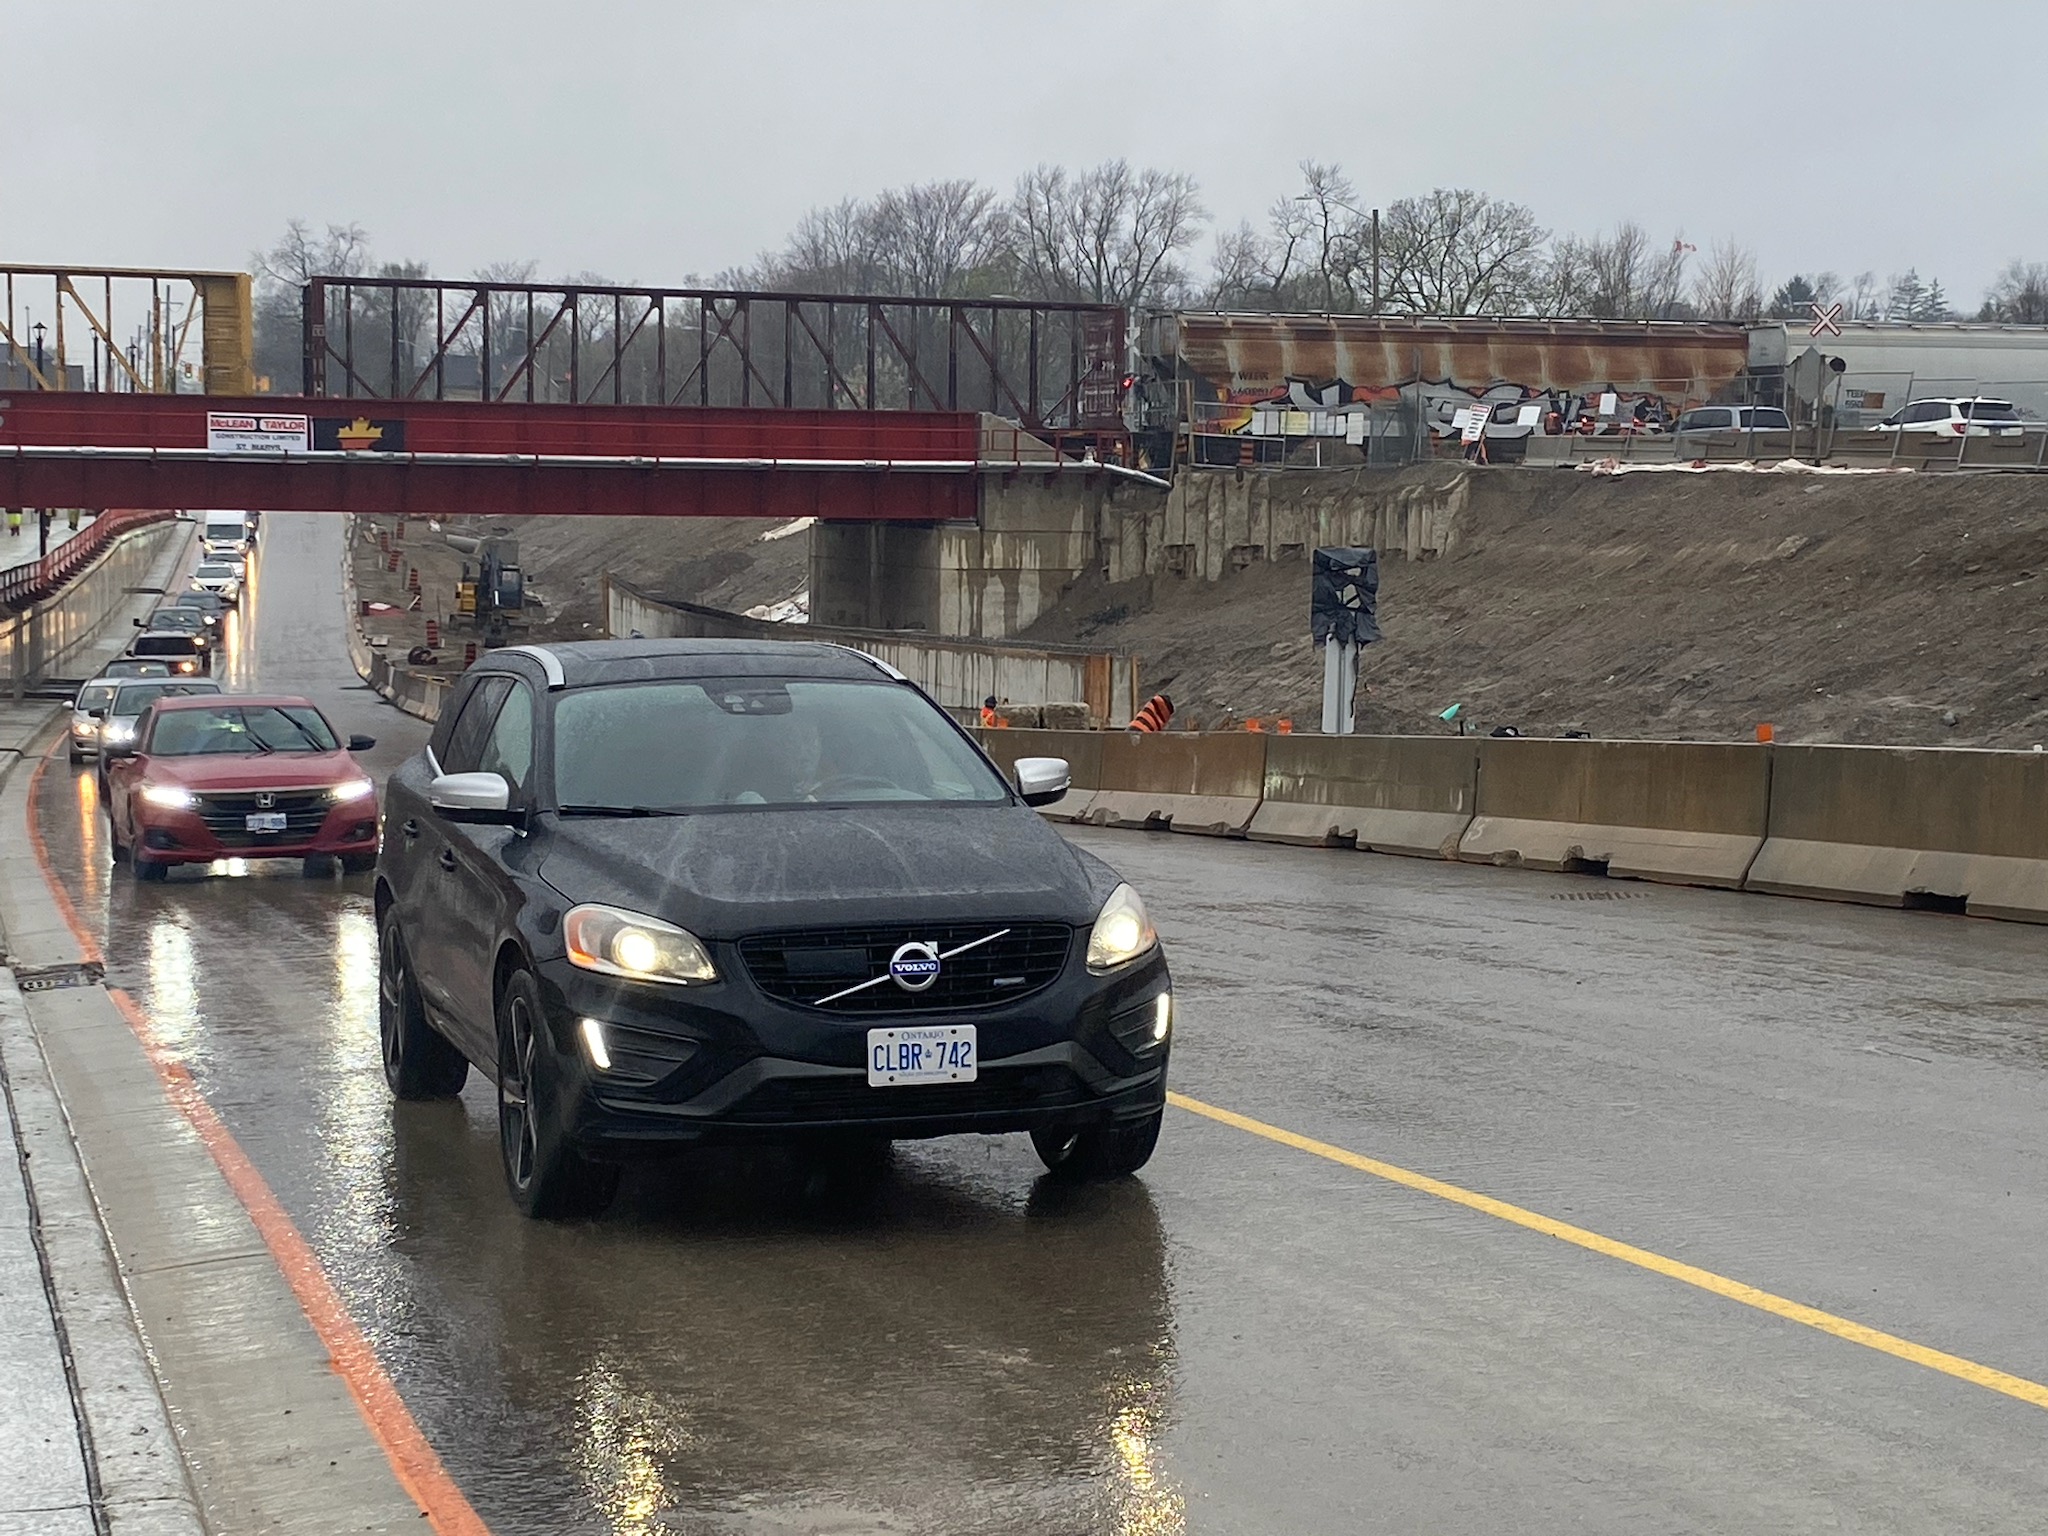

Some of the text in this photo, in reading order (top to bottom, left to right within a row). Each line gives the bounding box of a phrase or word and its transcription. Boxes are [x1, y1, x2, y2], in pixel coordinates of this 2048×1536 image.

[264, 420, 306, 430] TAYLOR
[894, 963, 937, 972] VOLVO
[873, 1041, 972, 1072] CLBR 742
